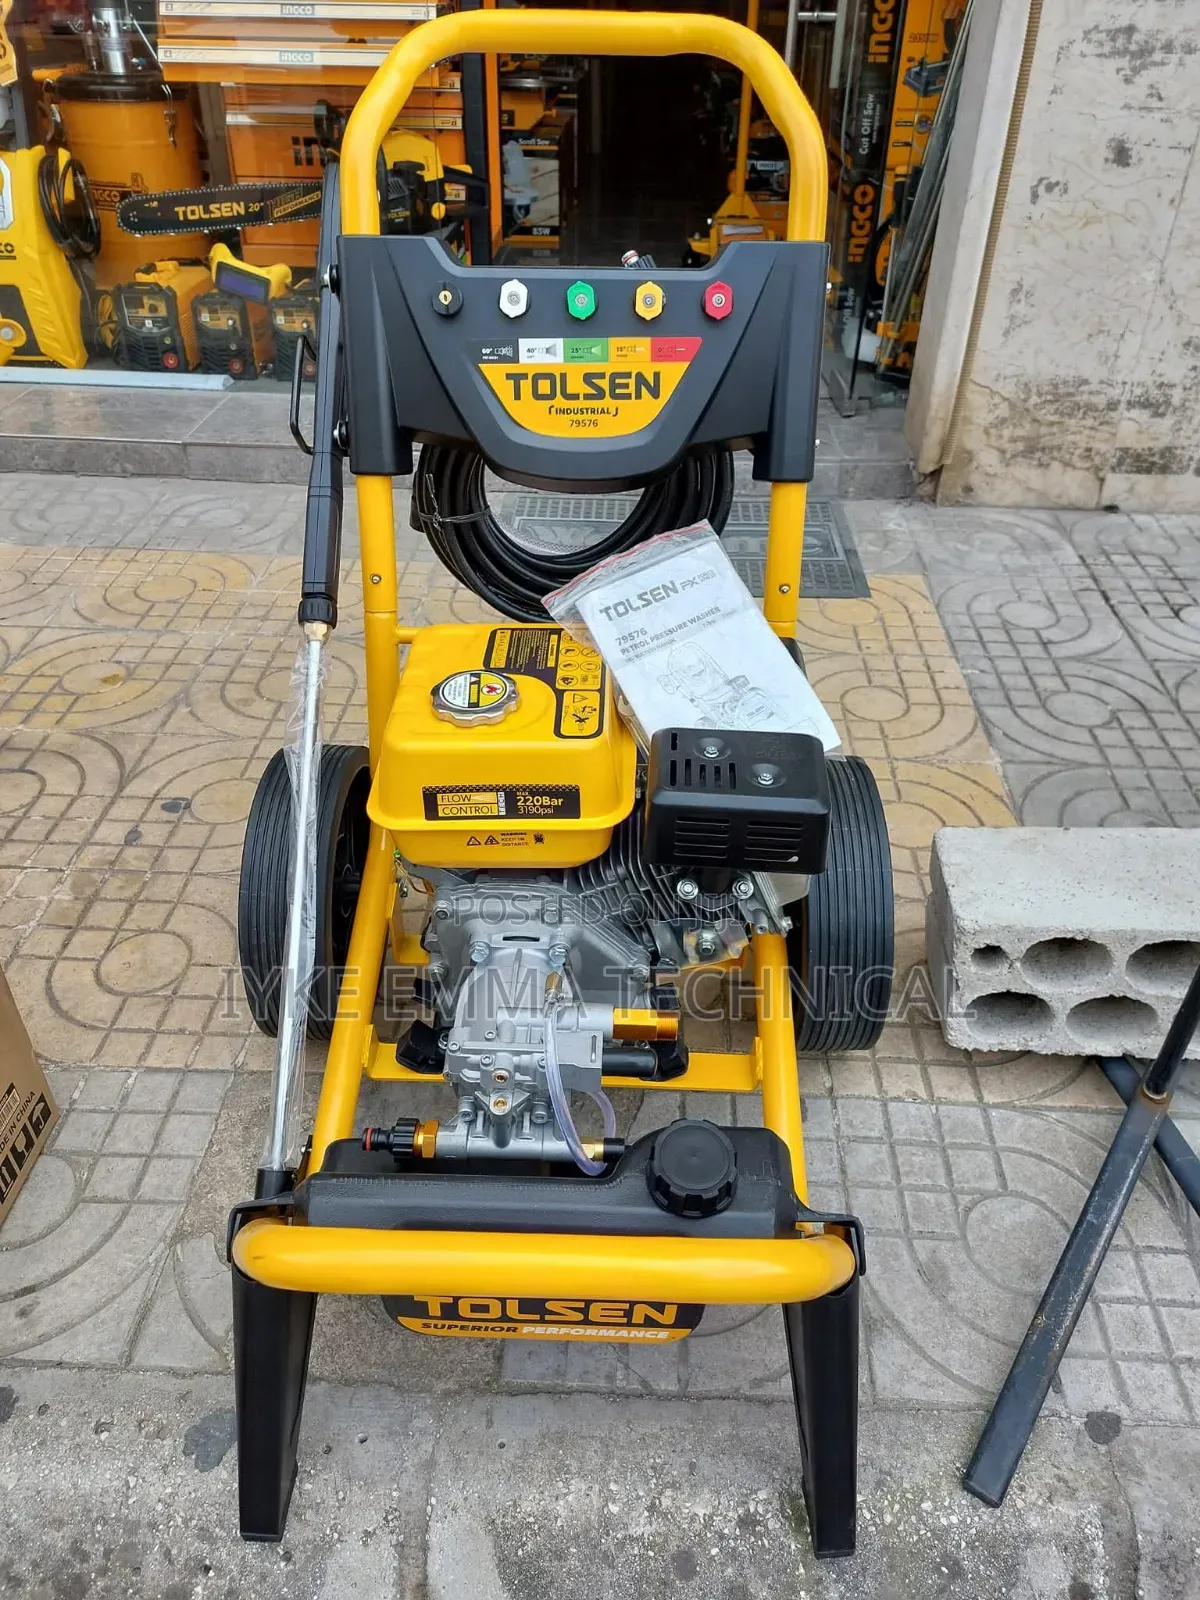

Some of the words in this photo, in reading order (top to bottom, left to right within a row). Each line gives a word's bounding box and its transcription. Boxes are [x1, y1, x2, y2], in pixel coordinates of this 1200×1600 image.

[863, 93, 875, 116] Saw
[174, 201, 245, 221] TOLSEN
[505, 371, 661, 401] TOLSEN
[554, 407, 612, 416] INDUSTRIAL
[569, 420, 599, 428] 79576
[599, 580, 679, 622] TOLSEN
[615, 627, 648, 646] 79576
[620, 640, 650, 656] PETROL
[650, 620, 688, 644] PRESSURE
[687, 606, 721, 626] WASHER
[441, 794, 472, 803] FLOW
[498, 792, 506, 815] TECH
[516, 796, 564, 806] 220Bar
[442, 805, 495, 816] CONTROL
[517, 806, 554, 816] 3190psi
[9, 1123, 17, 1137] IN
[16, 1091, 36, 1123] CHINA
[413, 1296, 679, 1325] TOLSEN
[420, 1322, 519, 1334] SUPERIOR
[522, 1325, 669, 1340] PERFORMANCE
